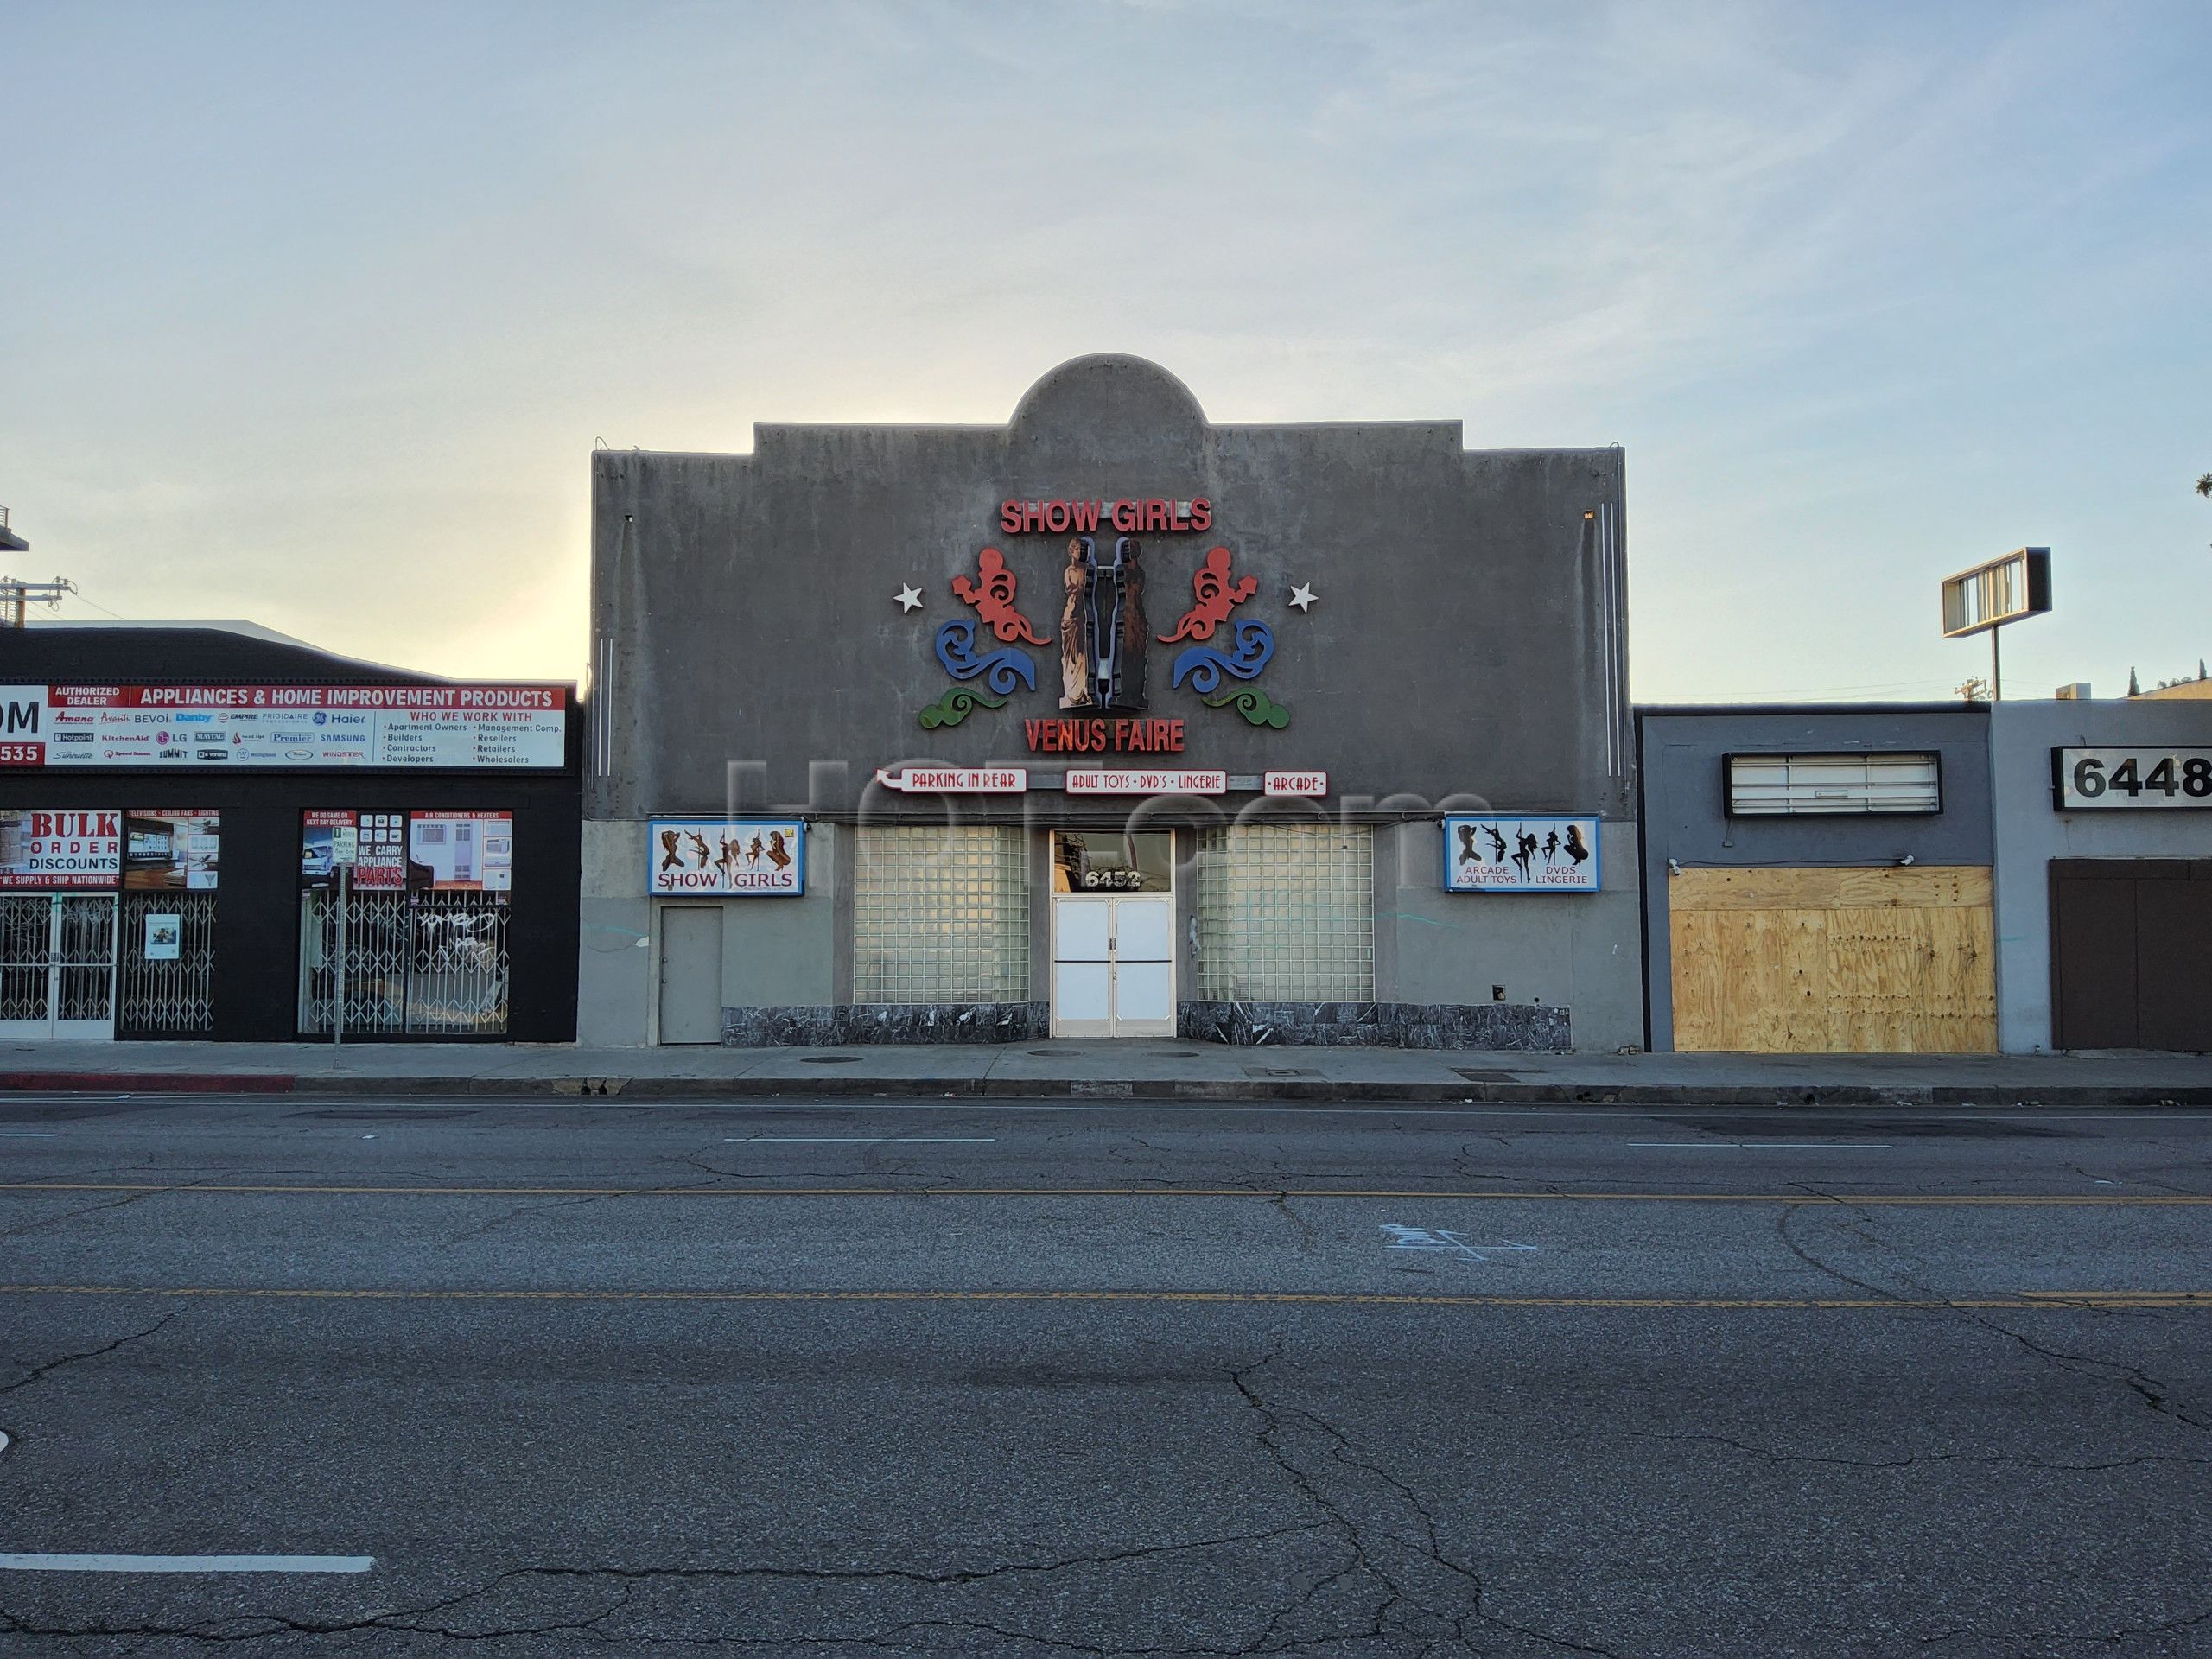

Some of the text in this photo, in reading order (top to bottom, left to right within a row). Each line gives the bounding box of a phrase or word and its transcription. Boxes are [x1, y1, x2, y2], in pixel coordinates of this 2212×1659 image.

[1001, 498, 1212, 533] SHOW GIRLS
[55, 687, 119, 696] AUTHORIZED
[140, 689, 553, 707] APPLIANCES & HOME IMPROVEMENT PRODUCTS
[0, 701, 39, 734] M
[55, 711, 94, 722] Amana
[176, 713, 212, 723] Danby
[331, 714, 365, 724] Haier
[410, 711, 532, 722] WHO WE WORK WITH
[388, 723, 467, 732] Apartment Owners
[478, 723, 562, 734] Management Comp.
[173, 733, 188, 742] LG
[321, 734, 365, 742] SAMSUNG
[388, 733, 423, 741] Builders
[1025, 719, 1185, 752] VENUS FAIRE
[387, 743, 436, 752] Contractors
[477, 744, 516, 753] Retailers
[159, 748, 188, 758] SUMMIT
[386, 754, 434, 764] Developers
[477, 755, 529, 764] Wholesalers
[912, 773, 1016, 787] PARKING IN REAR
[1071, 774, 1221, 789] ADULT TOYS DVD'S LINGERIE
[2074, 758, 2212, 798] 6448
[1273, 777, 1319, 791] ARCADE
[30, 812, 119, 838] BULK
[30, 842, 118, 854] ORDER
[359, 845, 404, 855] WE CARRY
[29, 858, 118, 870] DISCOUNTS
[358, 856, 402, 867] APPLIANCE
[1465, 866, 1509, 874] ARCADE
[1546, 866, 1576, 874] DVDS
[16, 875, 42, 885] SUPPLY
[53, 875, 69, 884] SHIP
[357, 867, 403, 885] PARTS
[658, 874, 792, 887] SHOW GIRLS
[1085, 871, 1141, 887] 6452
[1457, 875, 1517, 884] ADULT TOYS
[1535, 875, 1588, 884] LINGERIE
